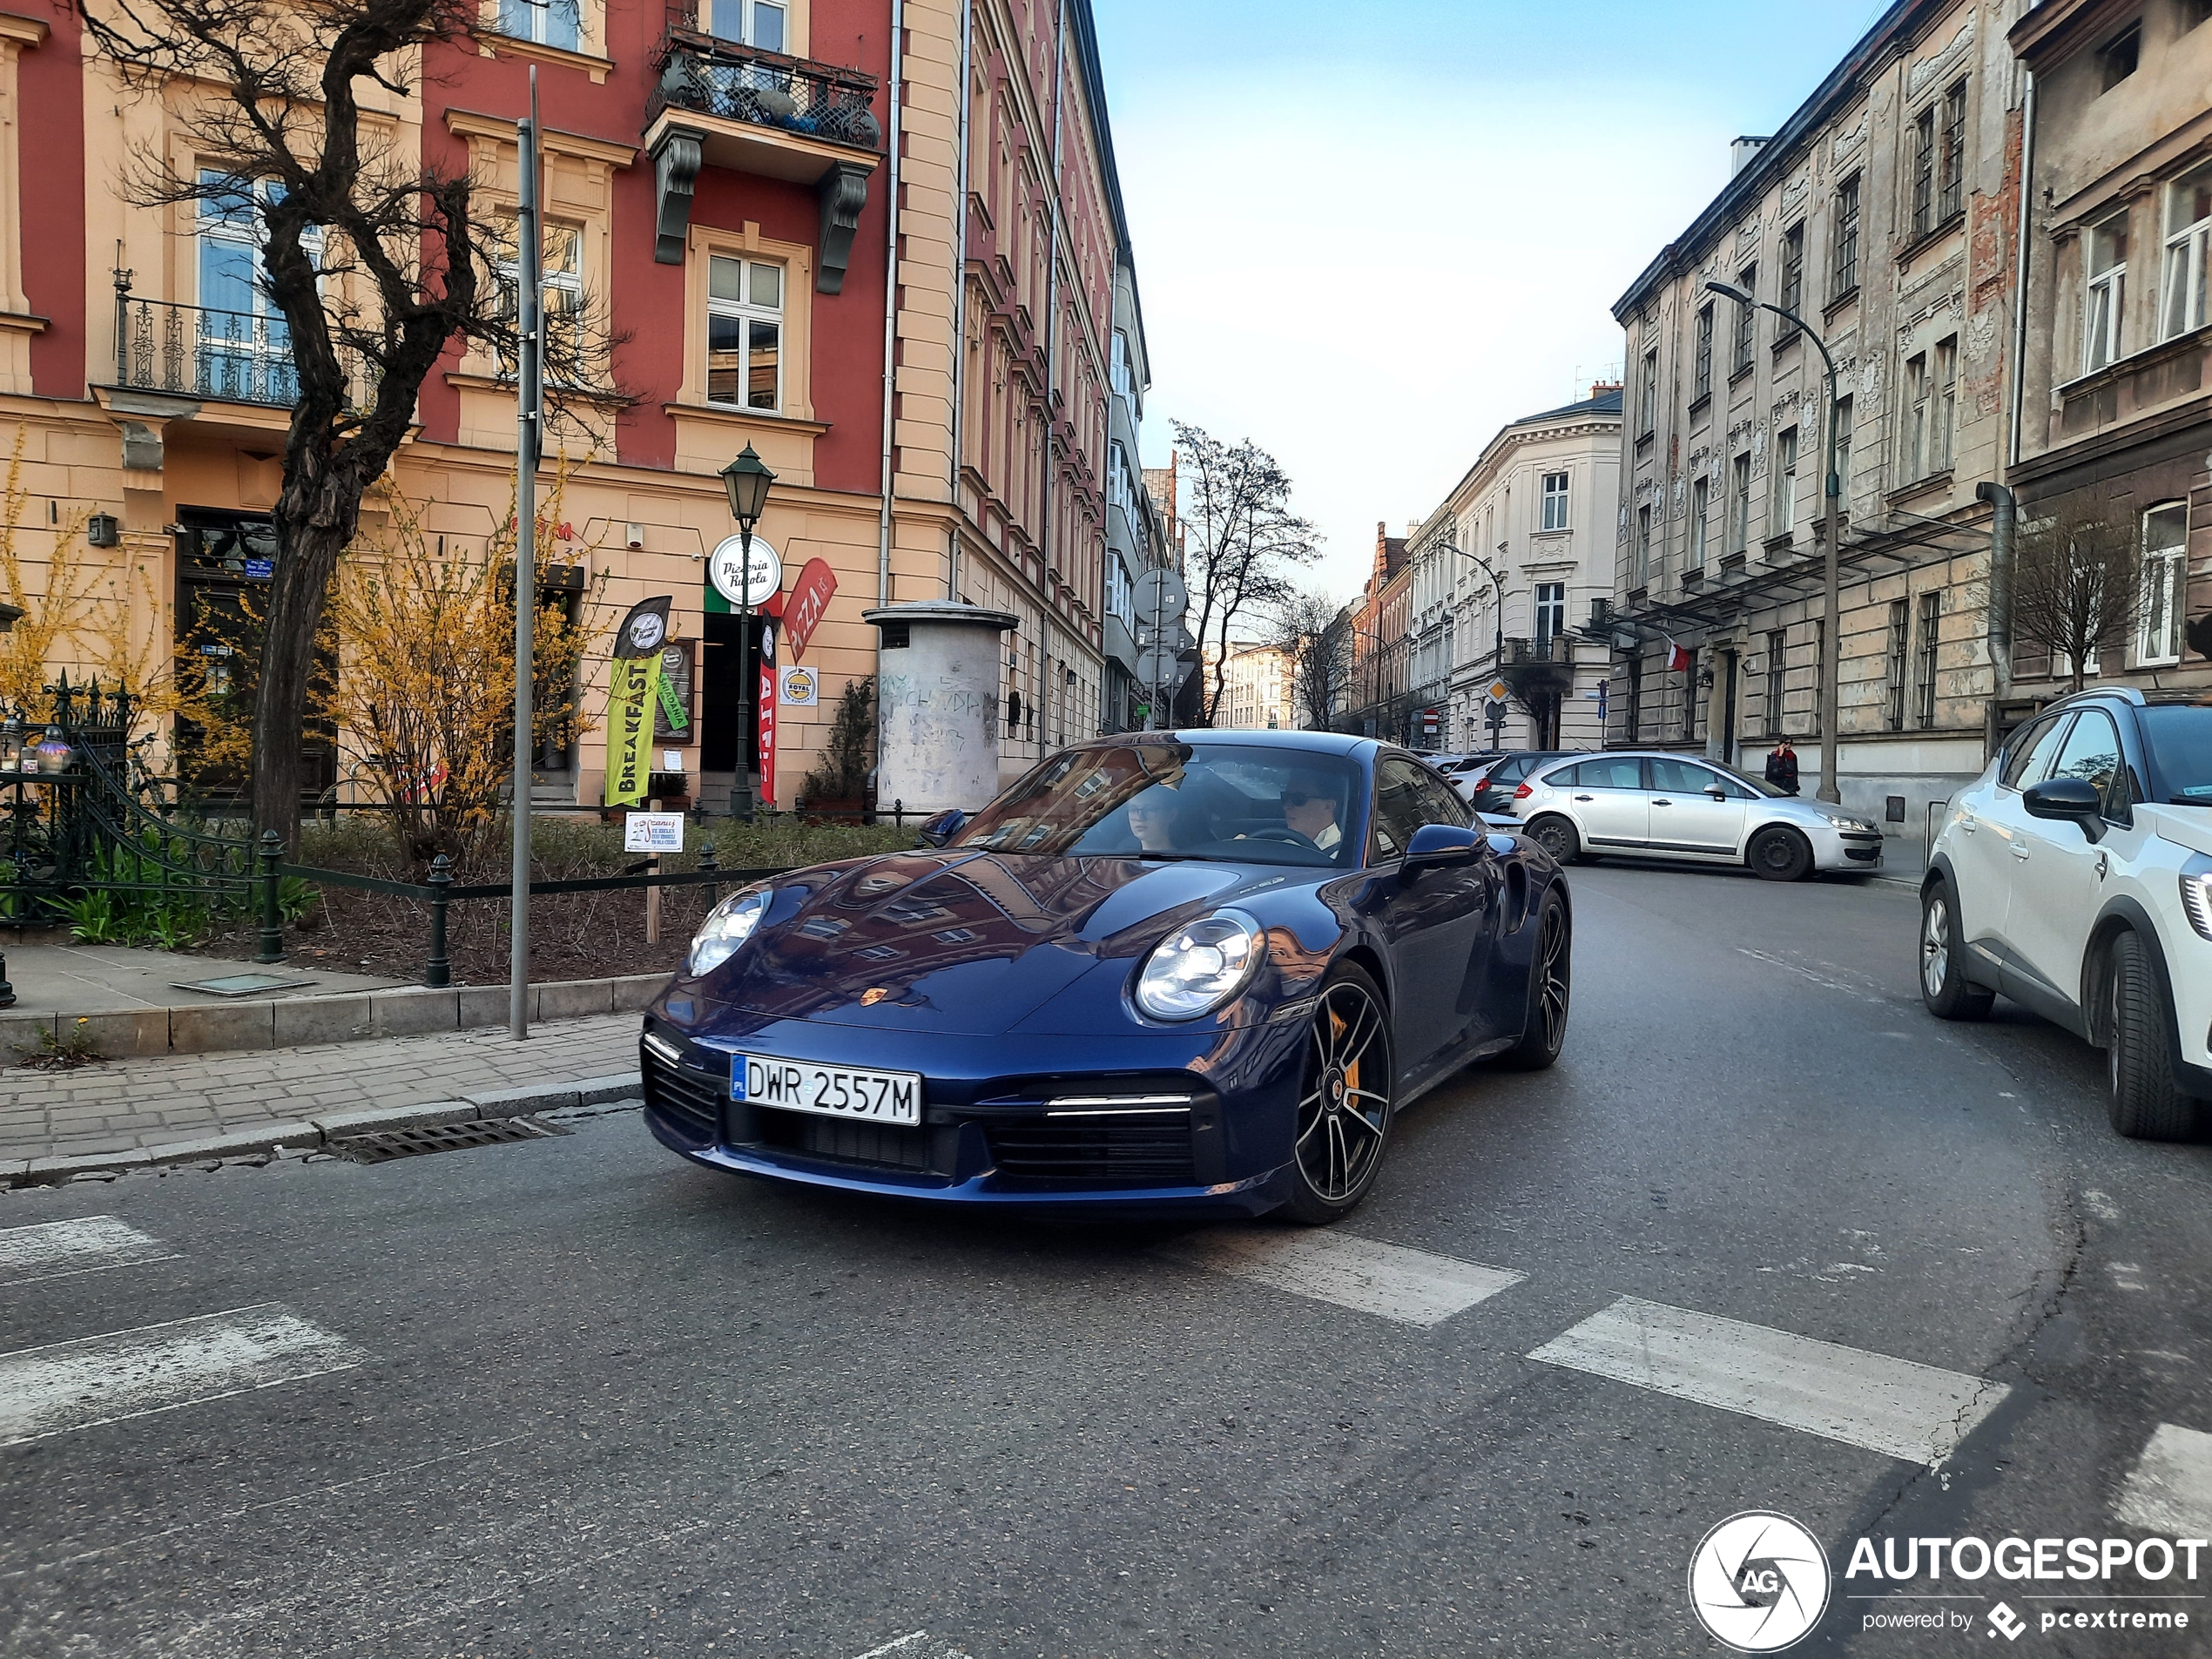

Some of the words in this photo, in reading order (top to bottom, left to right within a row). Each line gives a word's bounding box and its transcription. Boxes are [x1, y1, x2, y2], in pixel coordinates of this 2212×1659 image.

[723, 560, 769, 575] Pizzeria
[729, 571, 768, 588] Ruola
[659, 677, 685, 725] ŚNIADANIA
[618, 664, 648, 792] BREAKFAST
[733, 1082, 745, 1093] PL
[749, 1062, 801, 1105] DWR
[813, 1071, 912, 1118] 2557M
